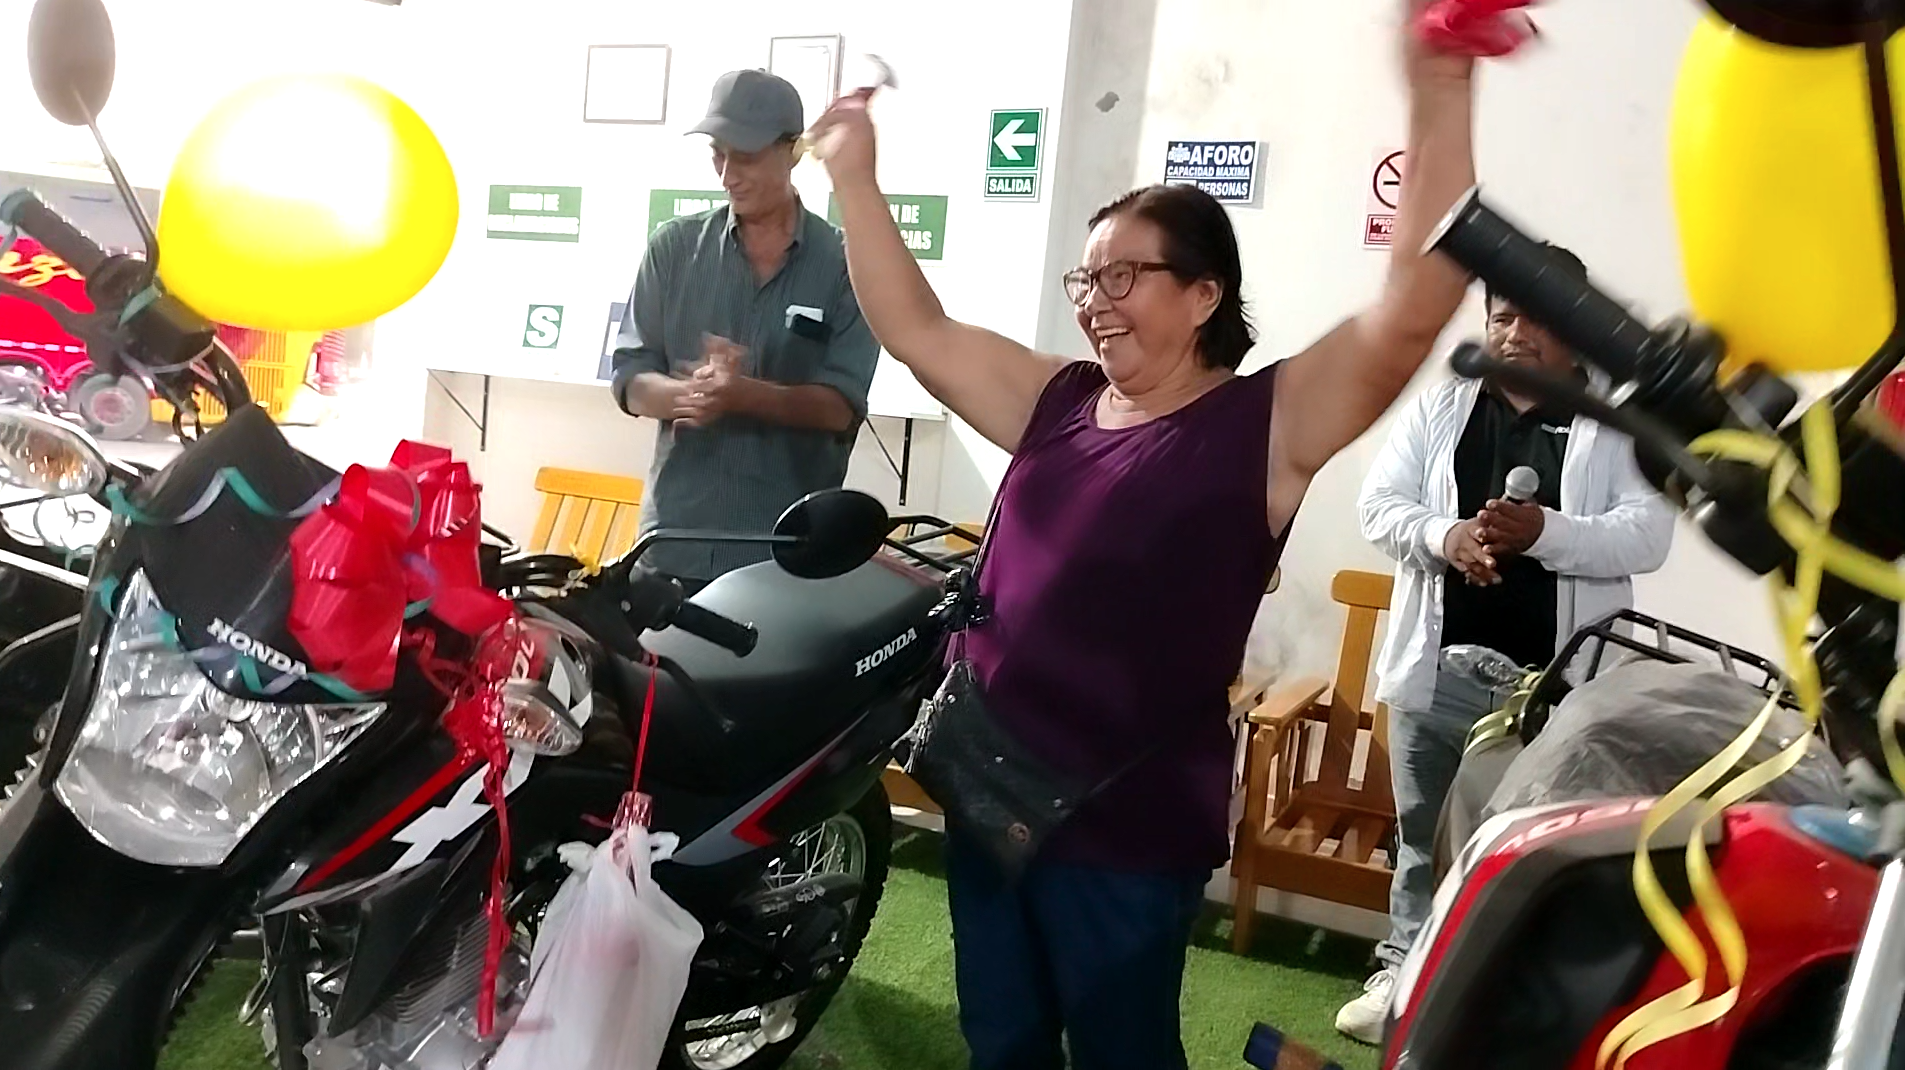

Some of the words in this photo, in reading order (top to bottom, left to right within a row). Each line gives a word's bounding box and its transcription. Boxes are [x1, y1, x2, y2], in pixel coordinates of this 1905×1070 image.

[1189, 145, 1254, 166] AFORO
[1167, 165, 1215, 177] CAPACIDAD
[1216, 165, 1250, 177] MAXIMA
[988, 178, 1032, 193] SALIDA
[900, 204, 920, 224] DE
[525, 306, 560, 348] S
[206, 617, 308, 680] HONDA
[855, 627, 918, 678] HONDA
